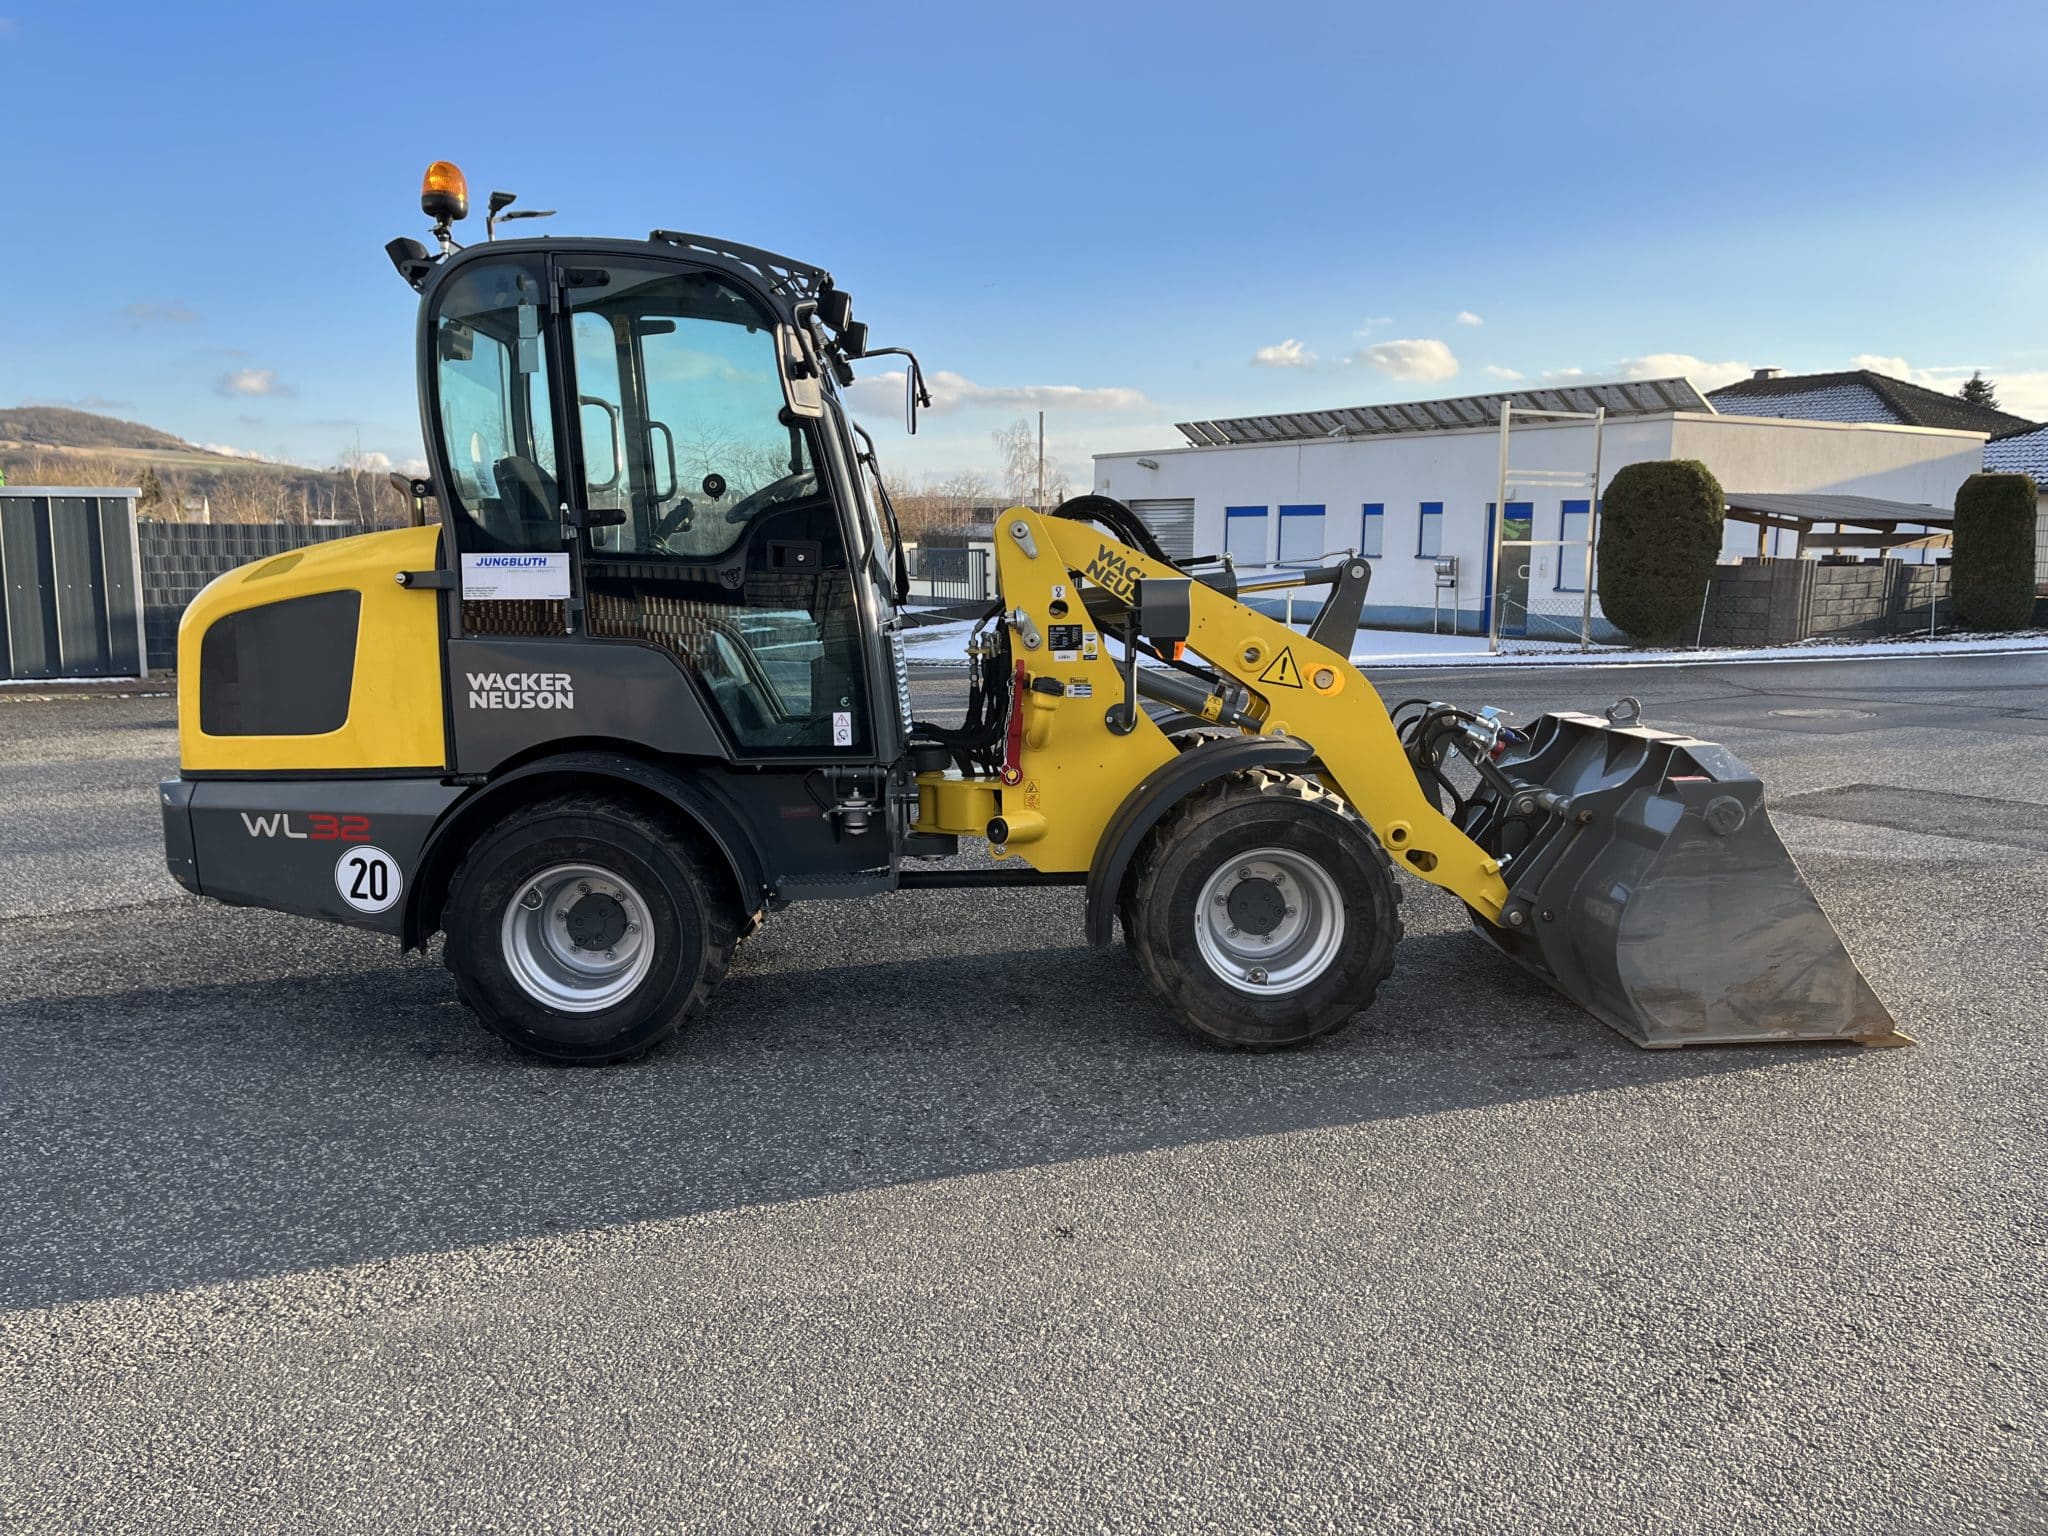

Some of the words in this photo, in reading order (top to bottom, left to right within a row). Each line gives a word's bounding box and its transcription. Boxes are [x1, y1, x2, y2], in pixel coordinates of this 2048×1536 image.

[476, 557, 547, 567] JUNGBLUTH
[1098, 544, 1149, 583] WAC
[465, 672, 574, 691] WACKER
[469, 691, 574, 709] NEUSON
[350, 857, 388, 901] 20
